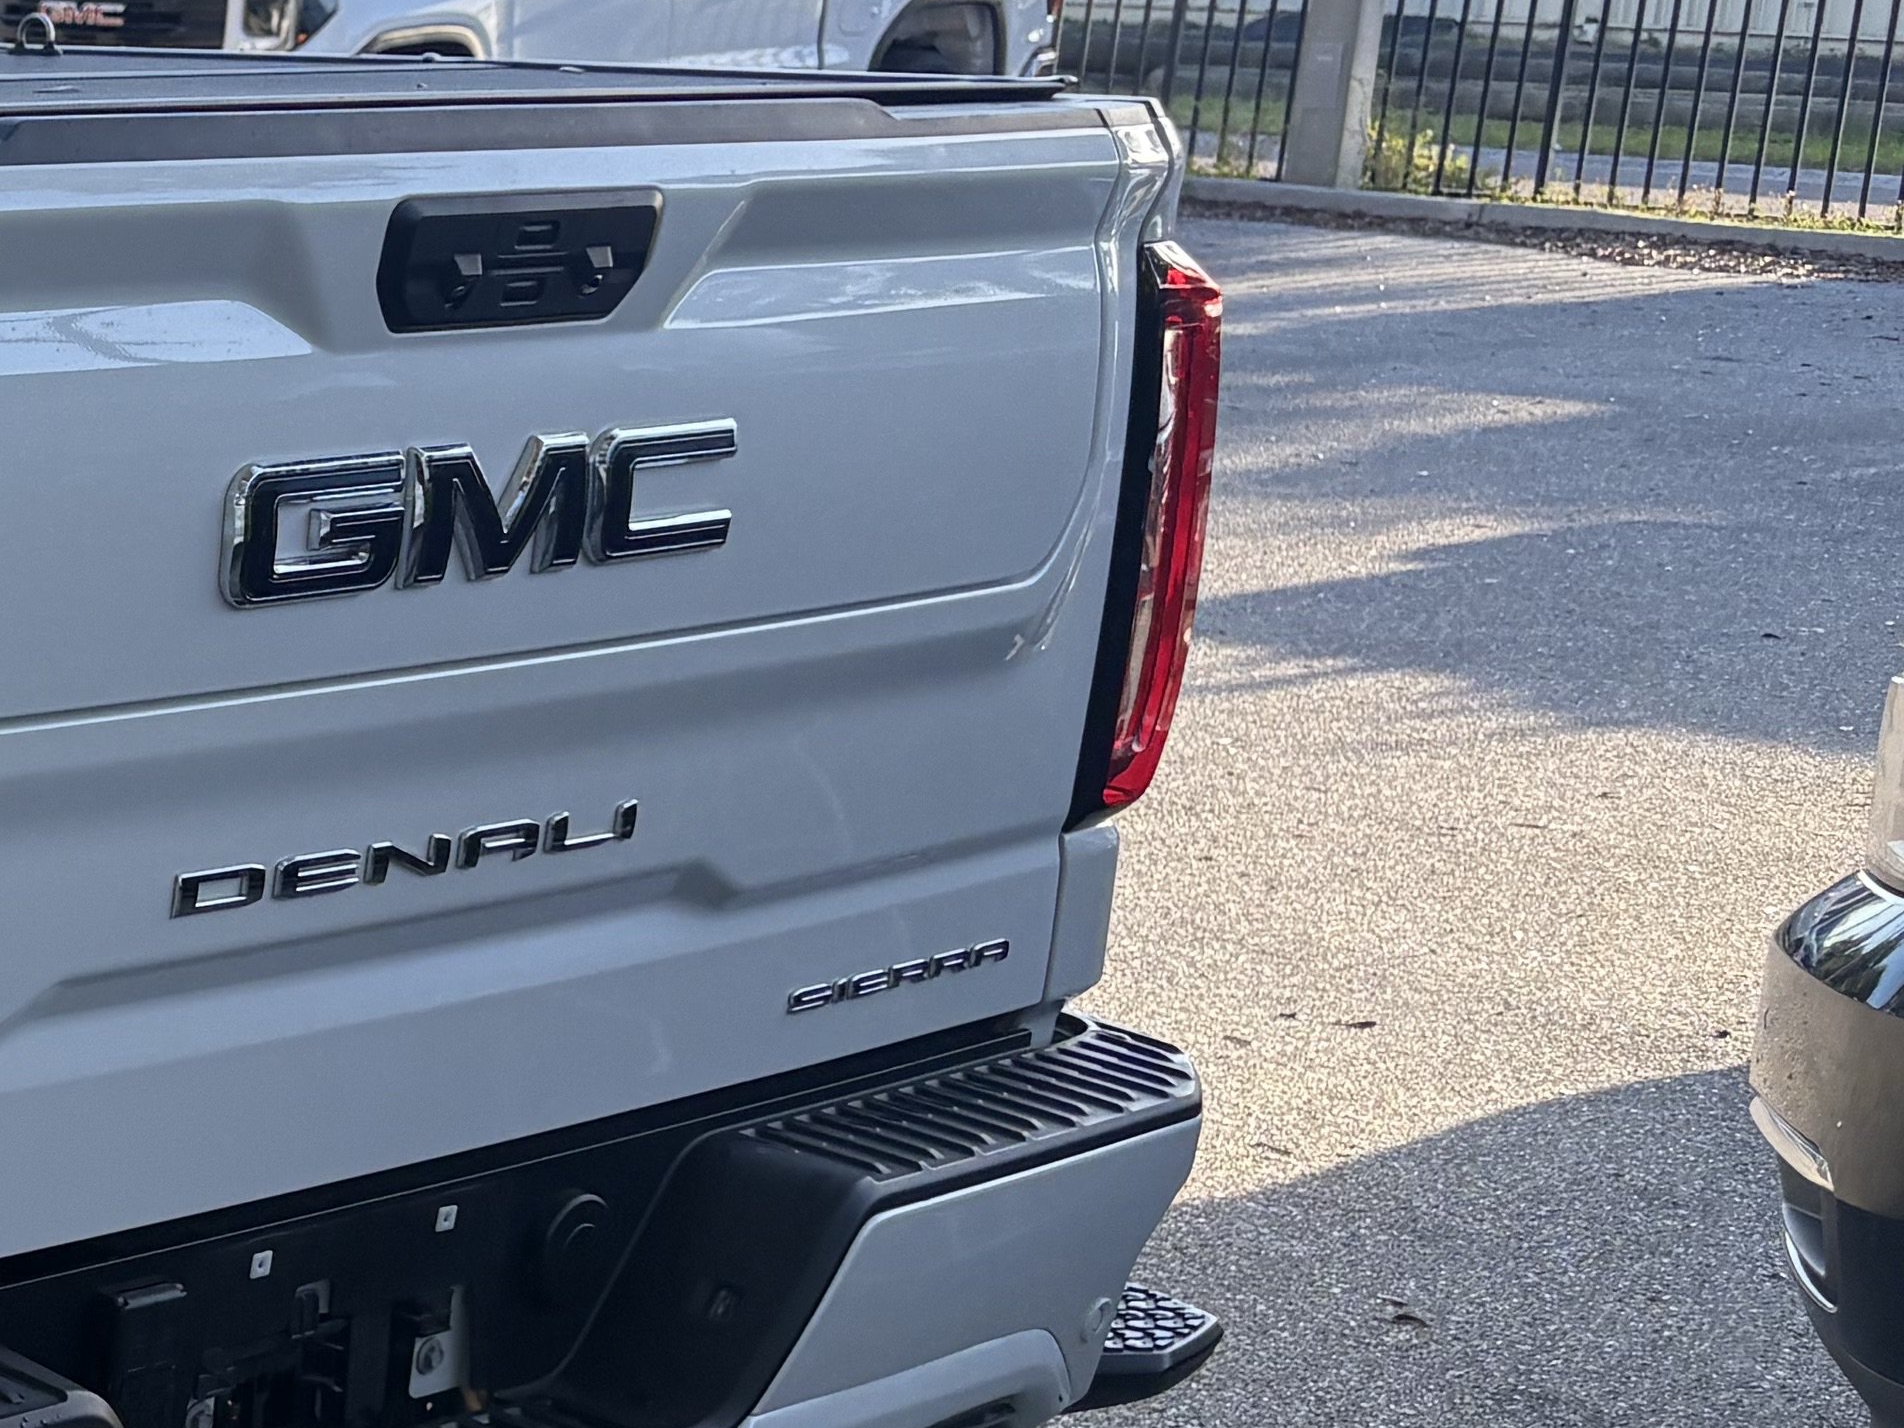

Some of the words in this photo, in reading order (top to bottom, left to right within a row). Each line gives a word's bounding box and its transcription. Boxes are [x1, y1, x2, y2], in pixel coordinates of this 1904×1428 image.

[39, 0, 126, 26] GMC
[218, 418, 737, 609] GMC
[170, 798, 638, 918] DENALI
[786, 938, 1010, 1014] SIERRA
